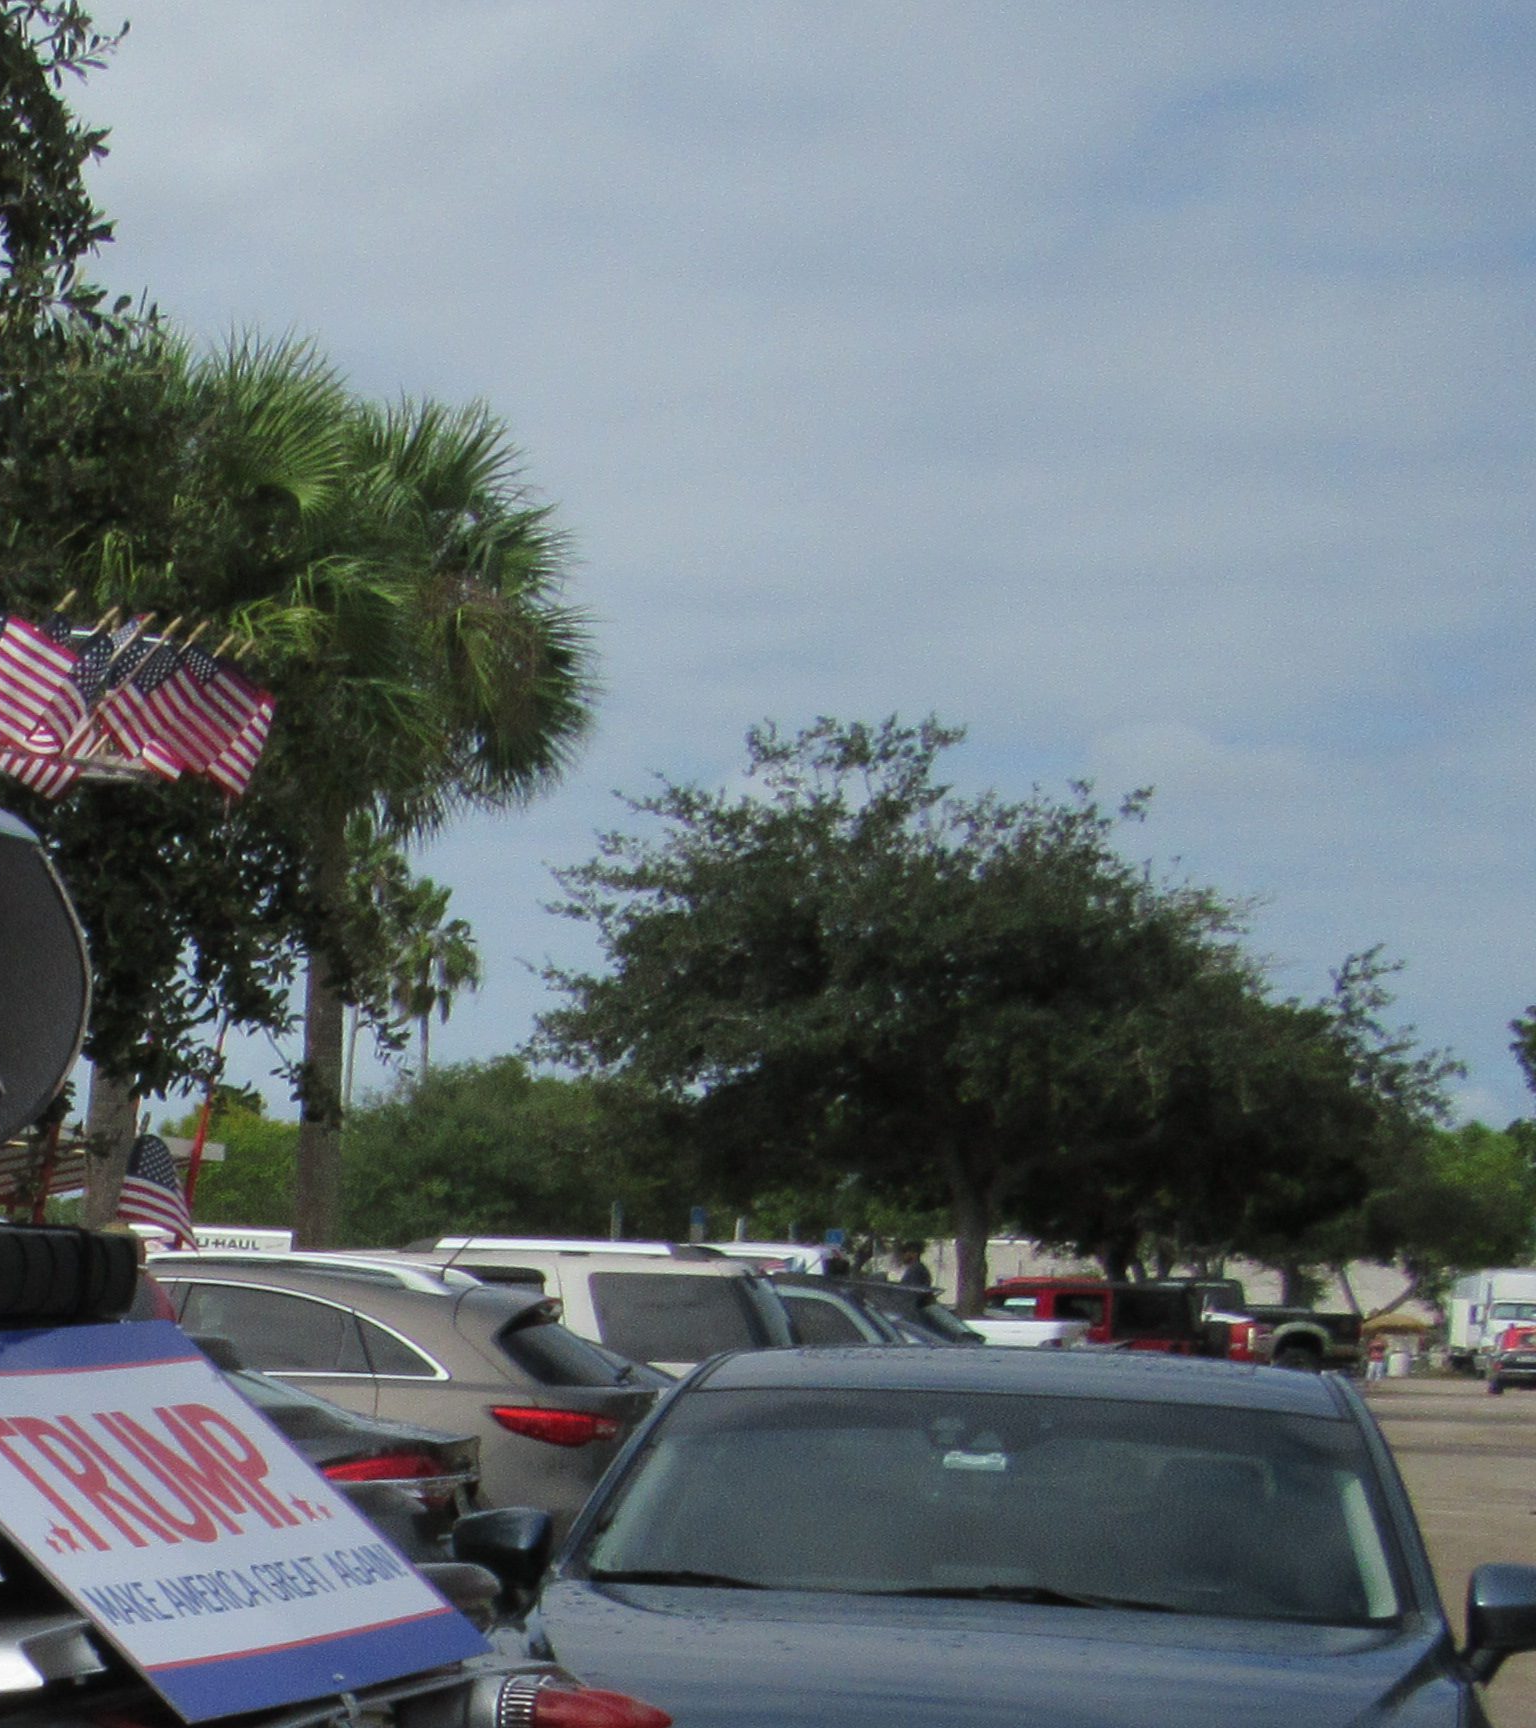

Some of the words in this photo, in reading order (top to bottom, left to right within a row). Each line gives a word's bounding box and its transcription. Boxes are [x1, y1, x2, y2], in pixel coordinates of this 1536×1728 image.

[81, 1580, 168, 1627] MAKE
[155, 1569, 261, 1619] AMERICA
[251, 1556, 326, 1604] GREAT
[325, 1543, 408, 1589] AGAIN!
